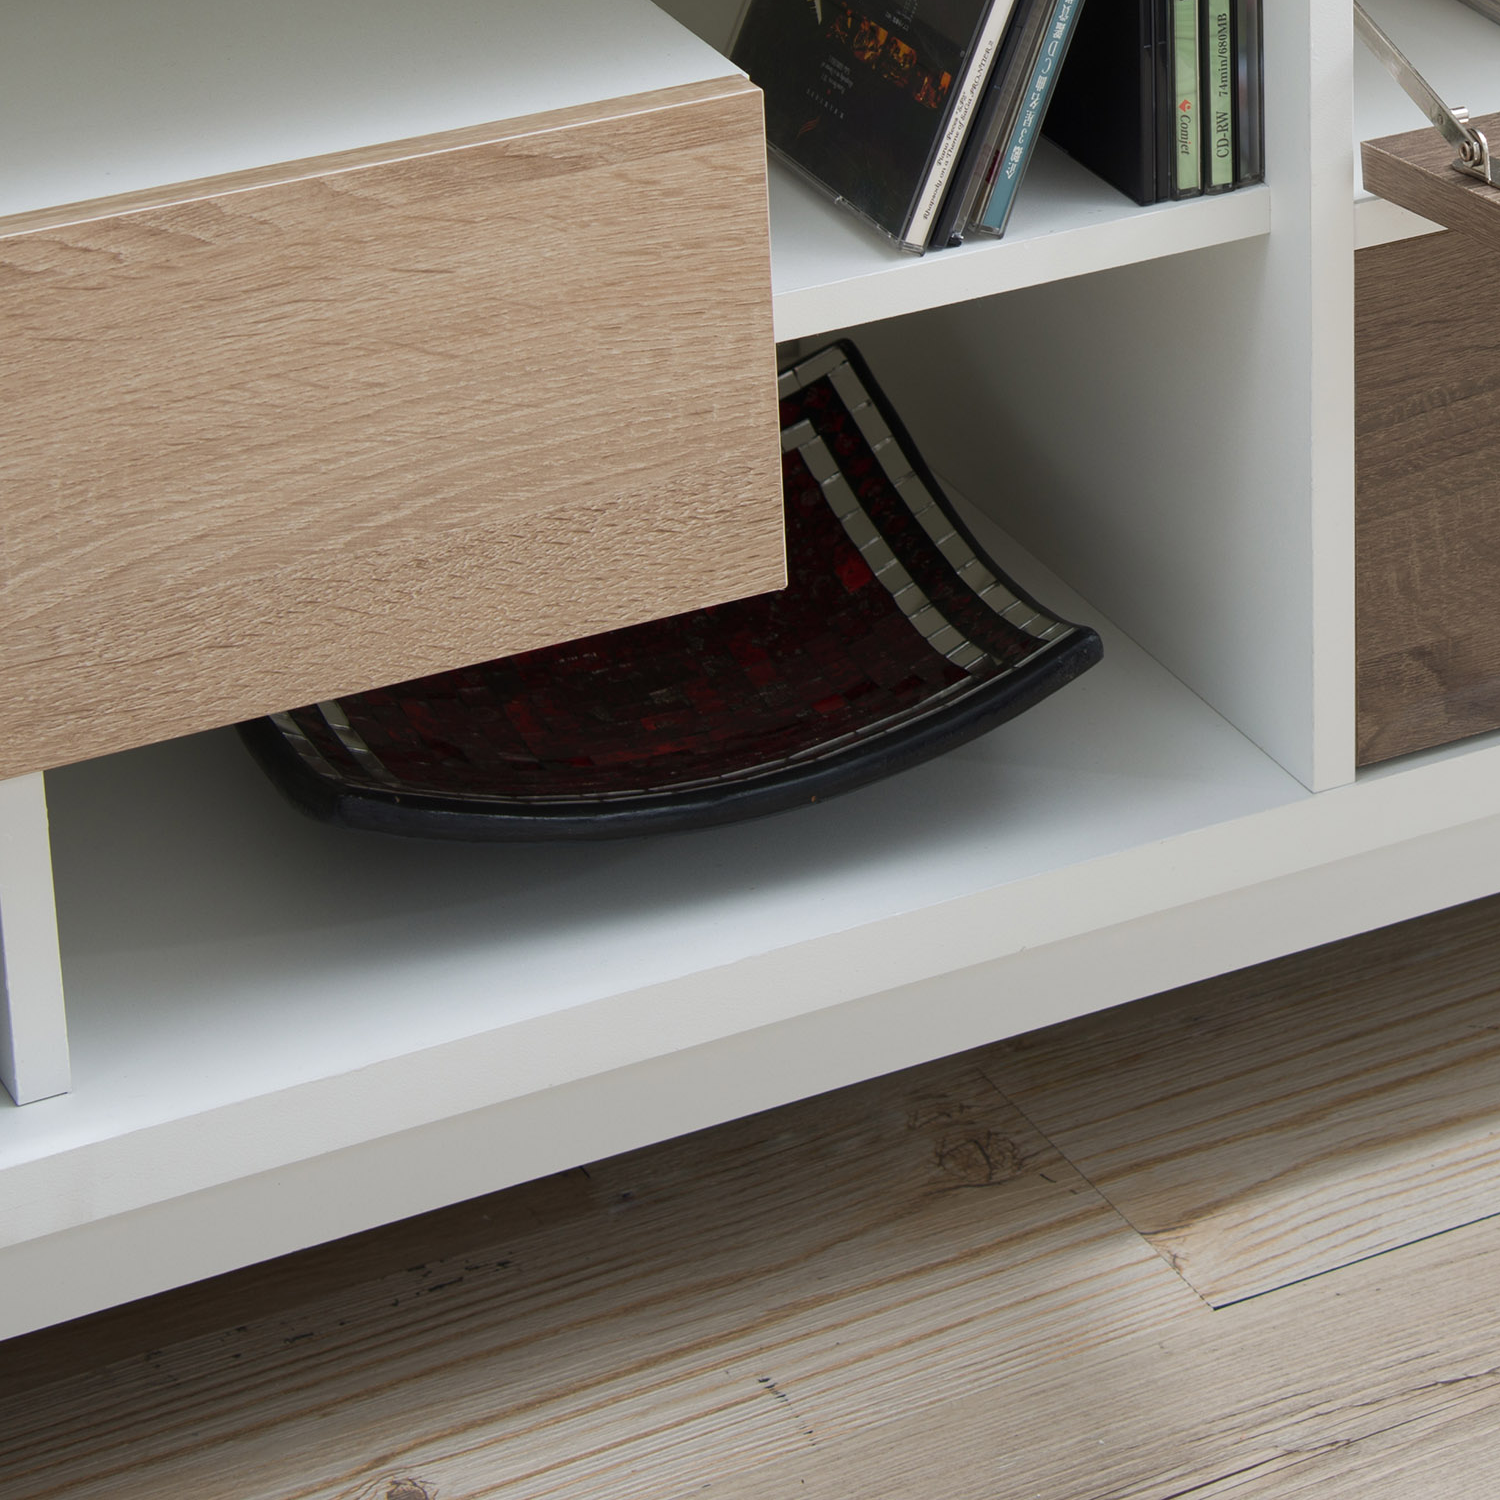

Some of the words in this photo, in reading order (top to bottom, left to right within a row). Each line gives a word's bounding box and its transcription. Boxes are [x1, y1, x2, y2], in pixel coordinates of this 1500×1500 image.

[1217, 13, 1228, 97] 74min/680MB
[1180, 114, 1191, 156] Comjet
[1216, 111, 1229, 158] CD-RW
